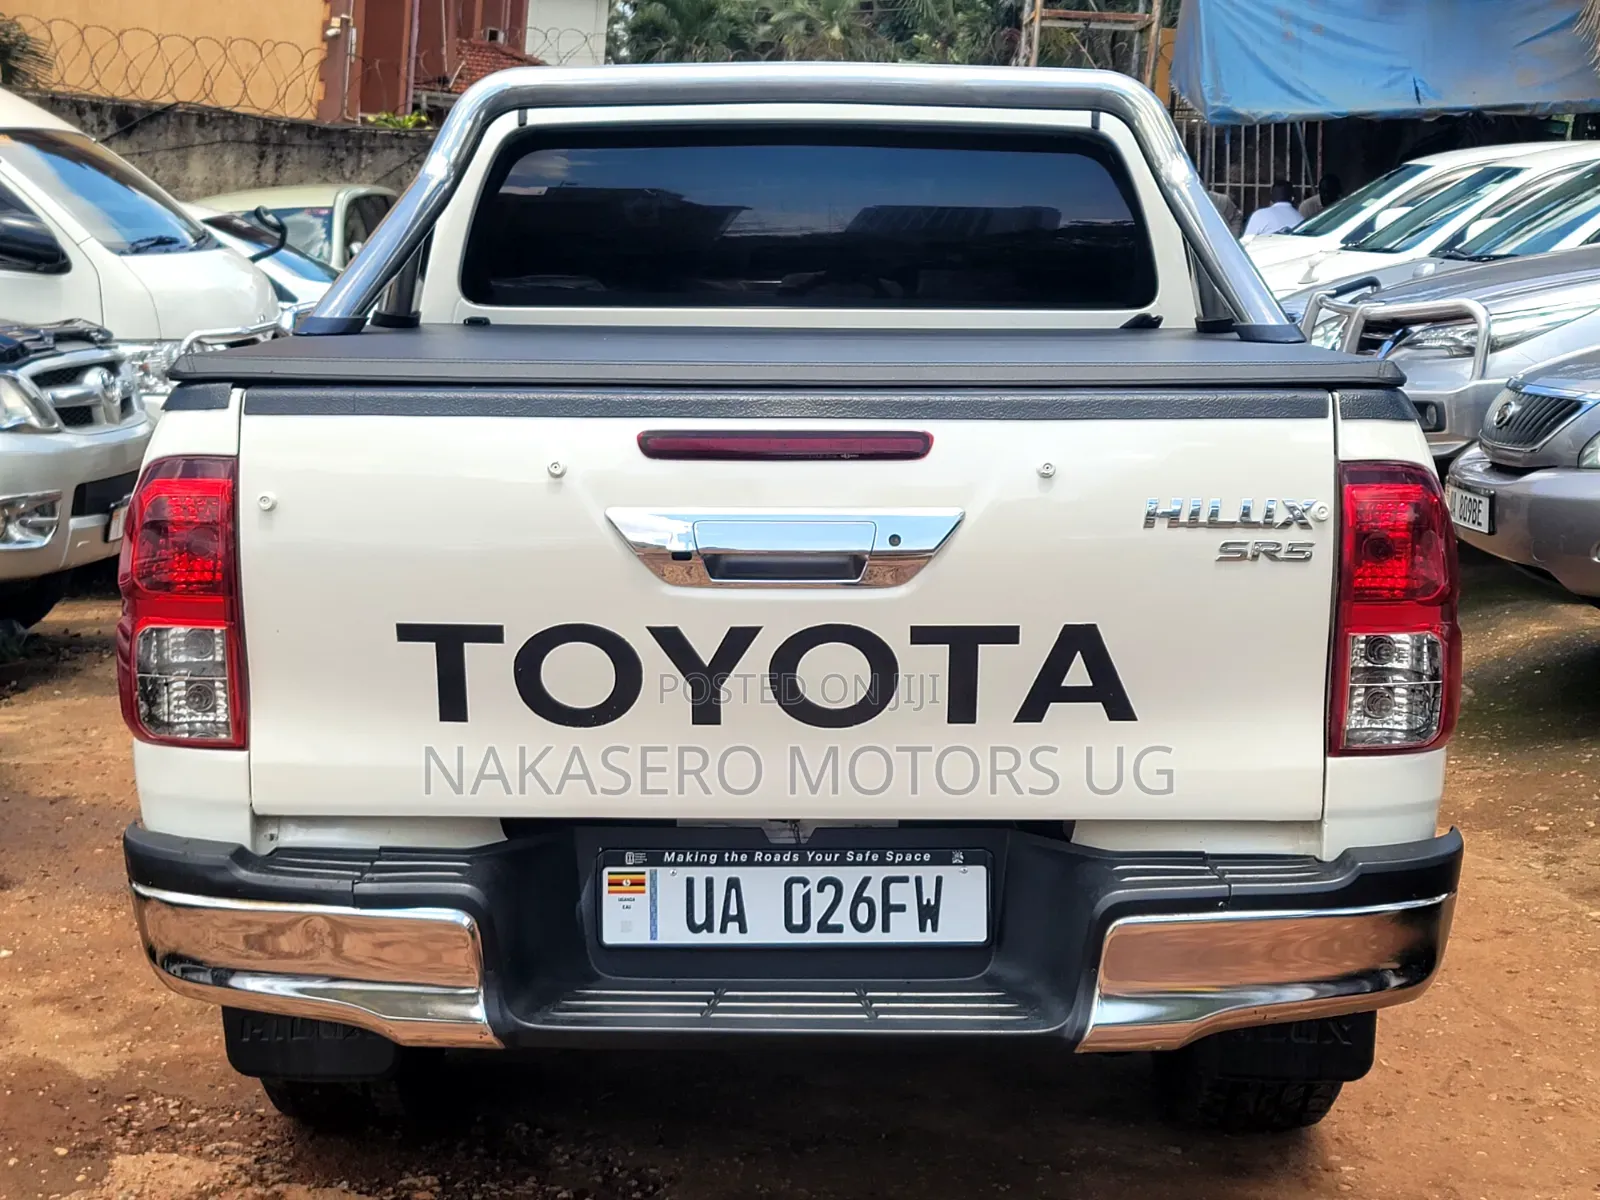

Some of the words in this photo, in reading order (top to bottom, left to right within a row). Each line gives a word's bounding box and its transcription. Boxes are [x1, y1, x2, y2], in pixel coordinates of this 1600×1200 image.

[1143, 497, 1317, 529] HILUX
[1215, 539, 1316, 562] SR5
[396, 622, 1138, 729] TOYOTA
[663, 851, 718, 865] Making
[724, 851, 748, 862] the
[754, 851, 800, 862] Roads
[806, 851, 840, 862] Your
[846, 851, 879, 862] Safe
[885, 851, 931, 864] Space
[685, 876, 748, 934] UA
[783, 875, 944, 934] 026FW
